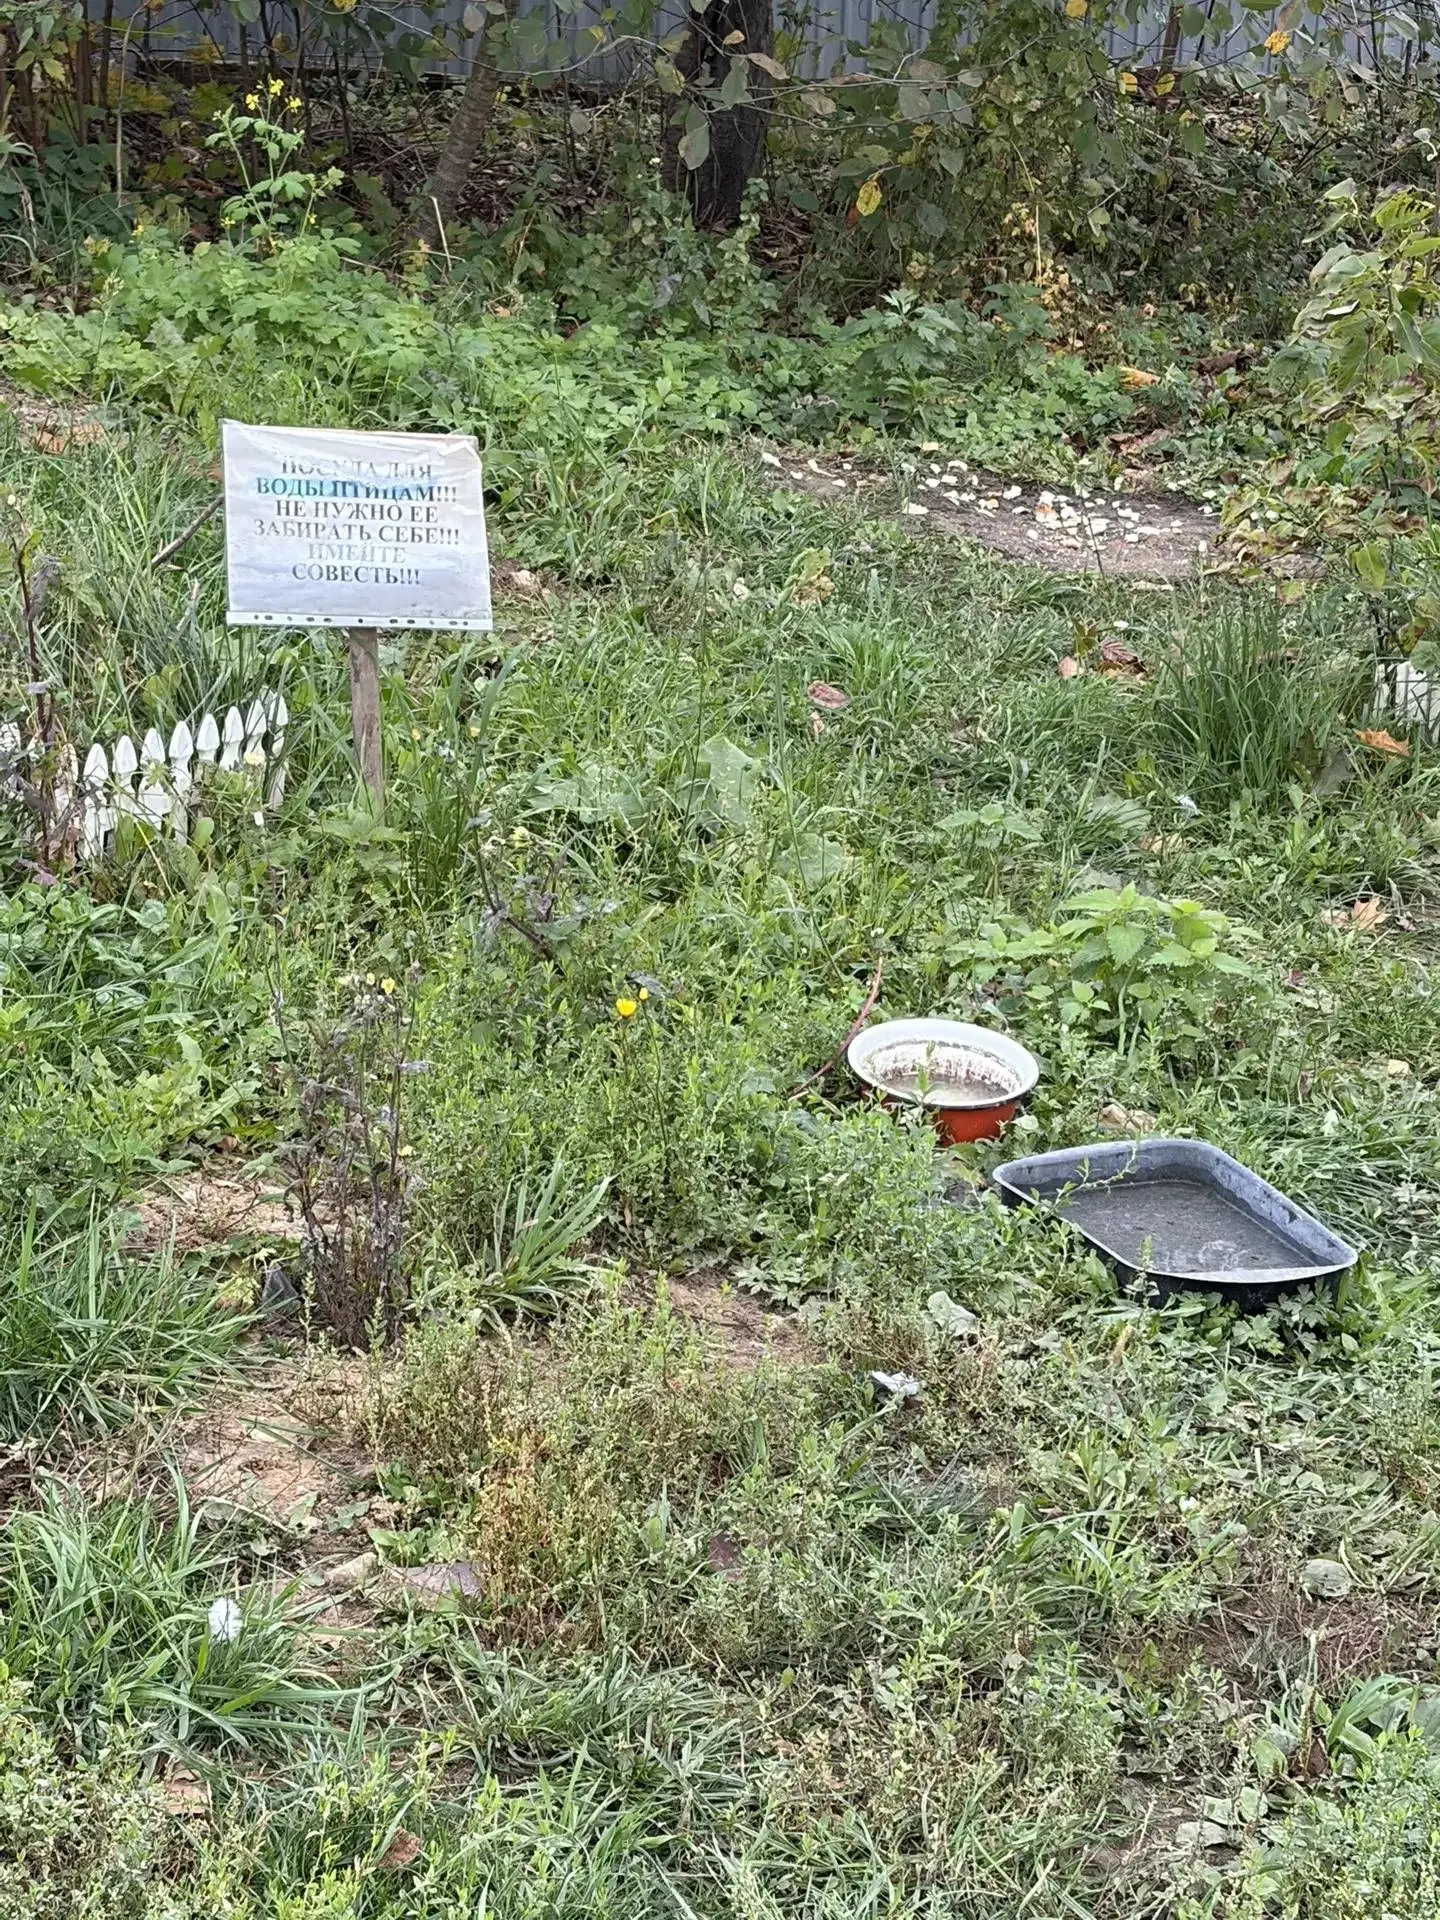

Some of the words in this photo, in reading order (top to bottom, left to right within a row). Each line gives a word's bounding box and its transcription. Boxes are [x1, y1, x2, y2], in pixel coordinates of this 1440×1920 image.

[256, 477, 324, 498] ВОДЫ
[331, 480, 457, 503] ПТИЦАМ!!!
[275, 499, 306, 518] НЕ
[314, 501, 403, 522] НУЖНО
[410, 506, 438, 524] ЕЕ
[254, 519, 371, 541] ЗАБИРАТЬ
[378, 525, 460, 545] СЕБЕ!!!
[308, 542, 407, 563] ИМЕЙТЕ
[291, 563, 421, 585] СОВЕСТЬ!!!
